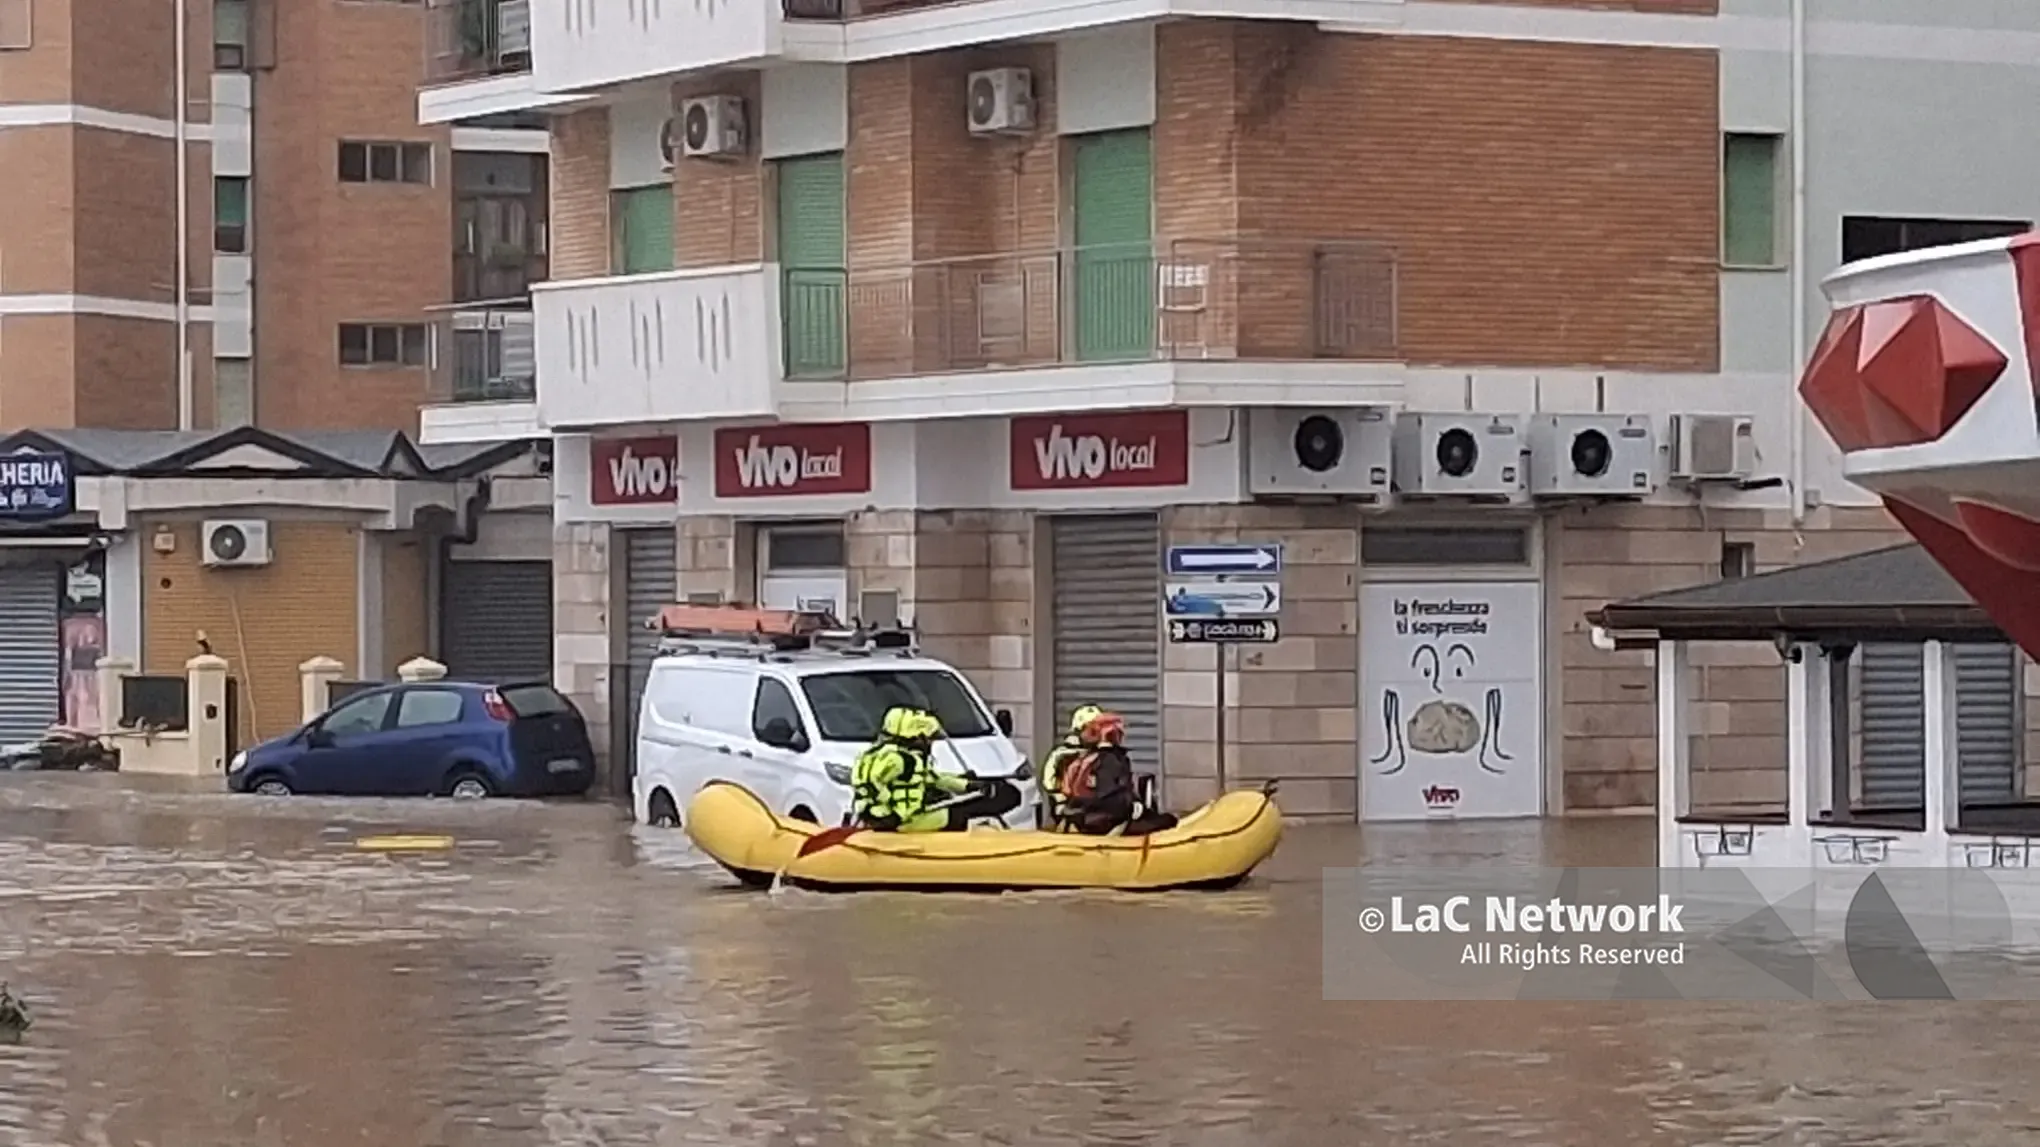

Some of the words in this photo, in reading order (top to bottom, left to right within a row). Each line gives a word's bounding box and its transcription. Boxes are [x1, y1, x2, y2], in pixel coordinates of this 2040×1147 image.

[801, 446, 843, 479] local
[1110, 435, 1157, 471] local
[0, 461, 64, 487] HERIA
